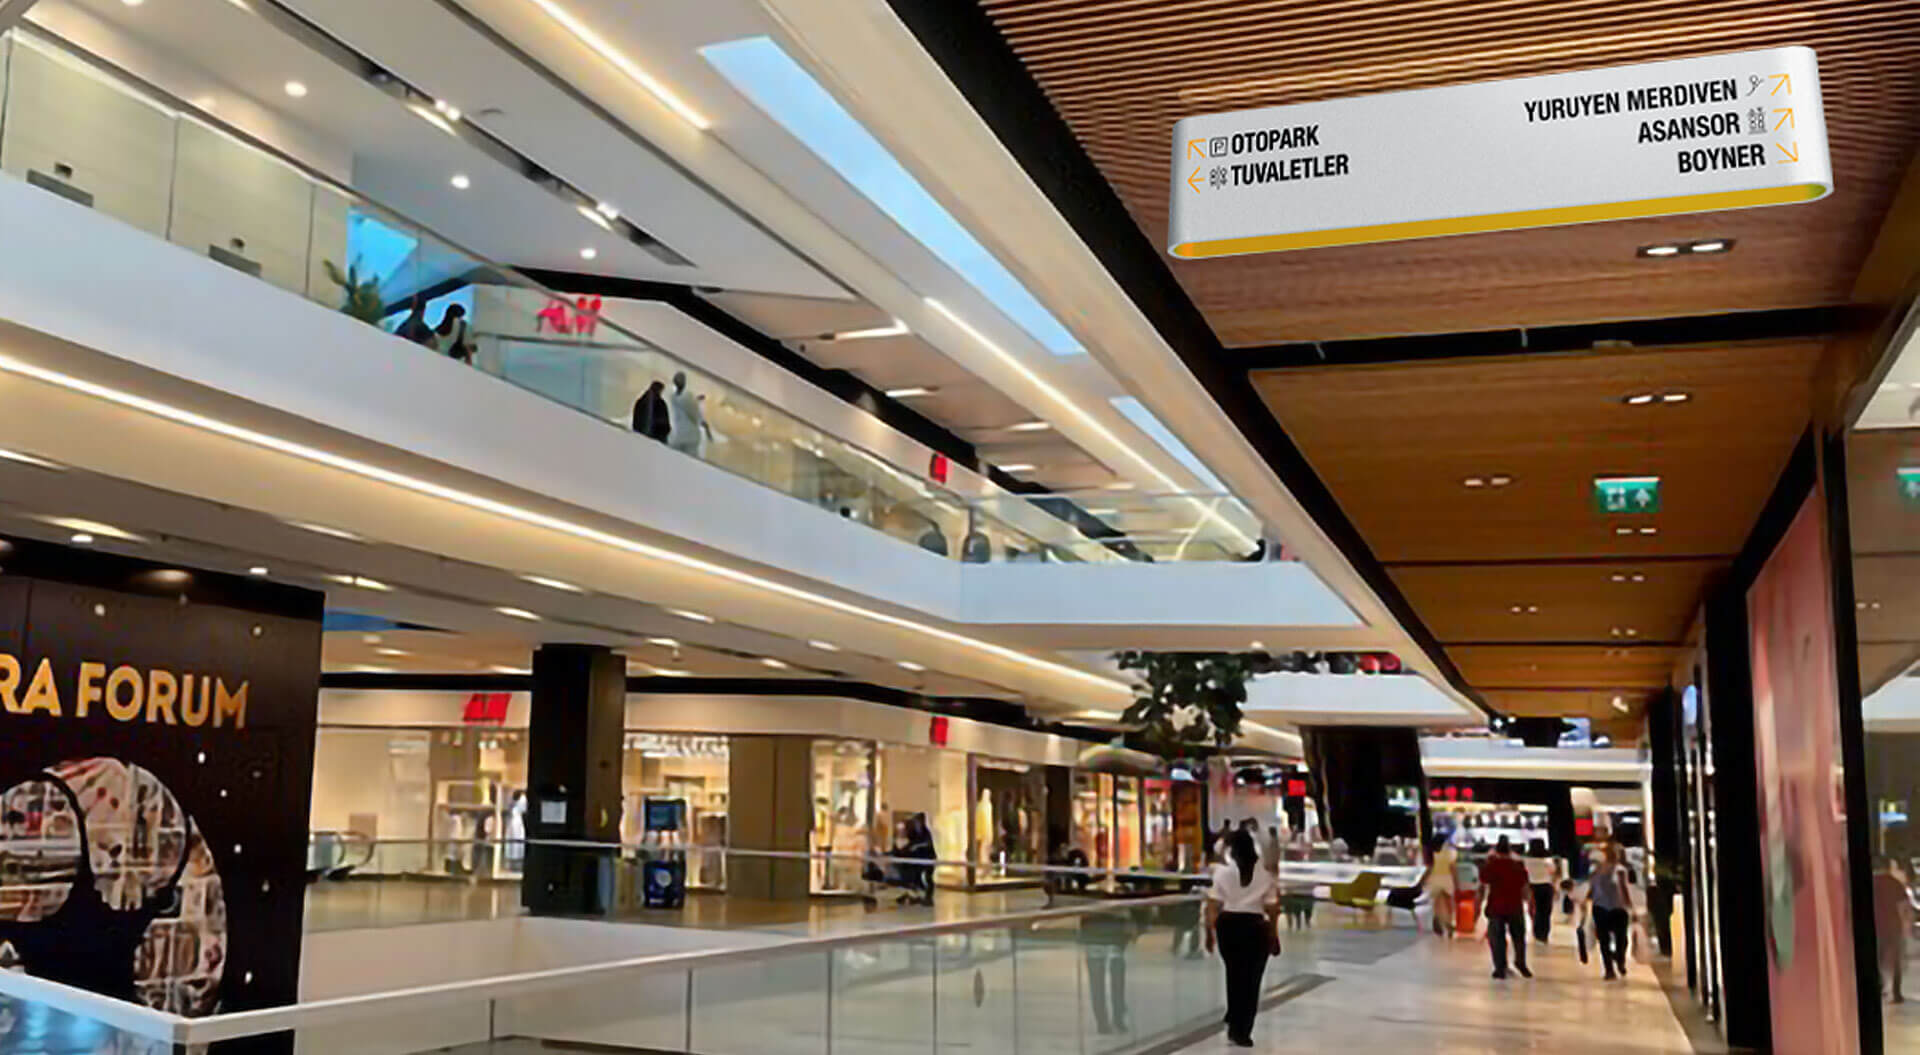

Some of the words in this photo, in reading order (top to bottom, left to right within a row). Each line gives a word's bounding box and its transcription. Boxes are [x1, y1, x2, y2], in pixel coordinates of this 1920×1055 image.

[1524, 92, 1620, 122] YURUYEN
[1627, 79, 1737, 111] MERDIVEN
[1231, 125, 1319, 154] OTOPARK
[1638, 112, 1740, 143] ASANSOR
[1231, 154, 1349, 186] TUVALETLER
[1677, 143, 1766, 174] BOYNER
[75, 661, 249, 729] FORUM
